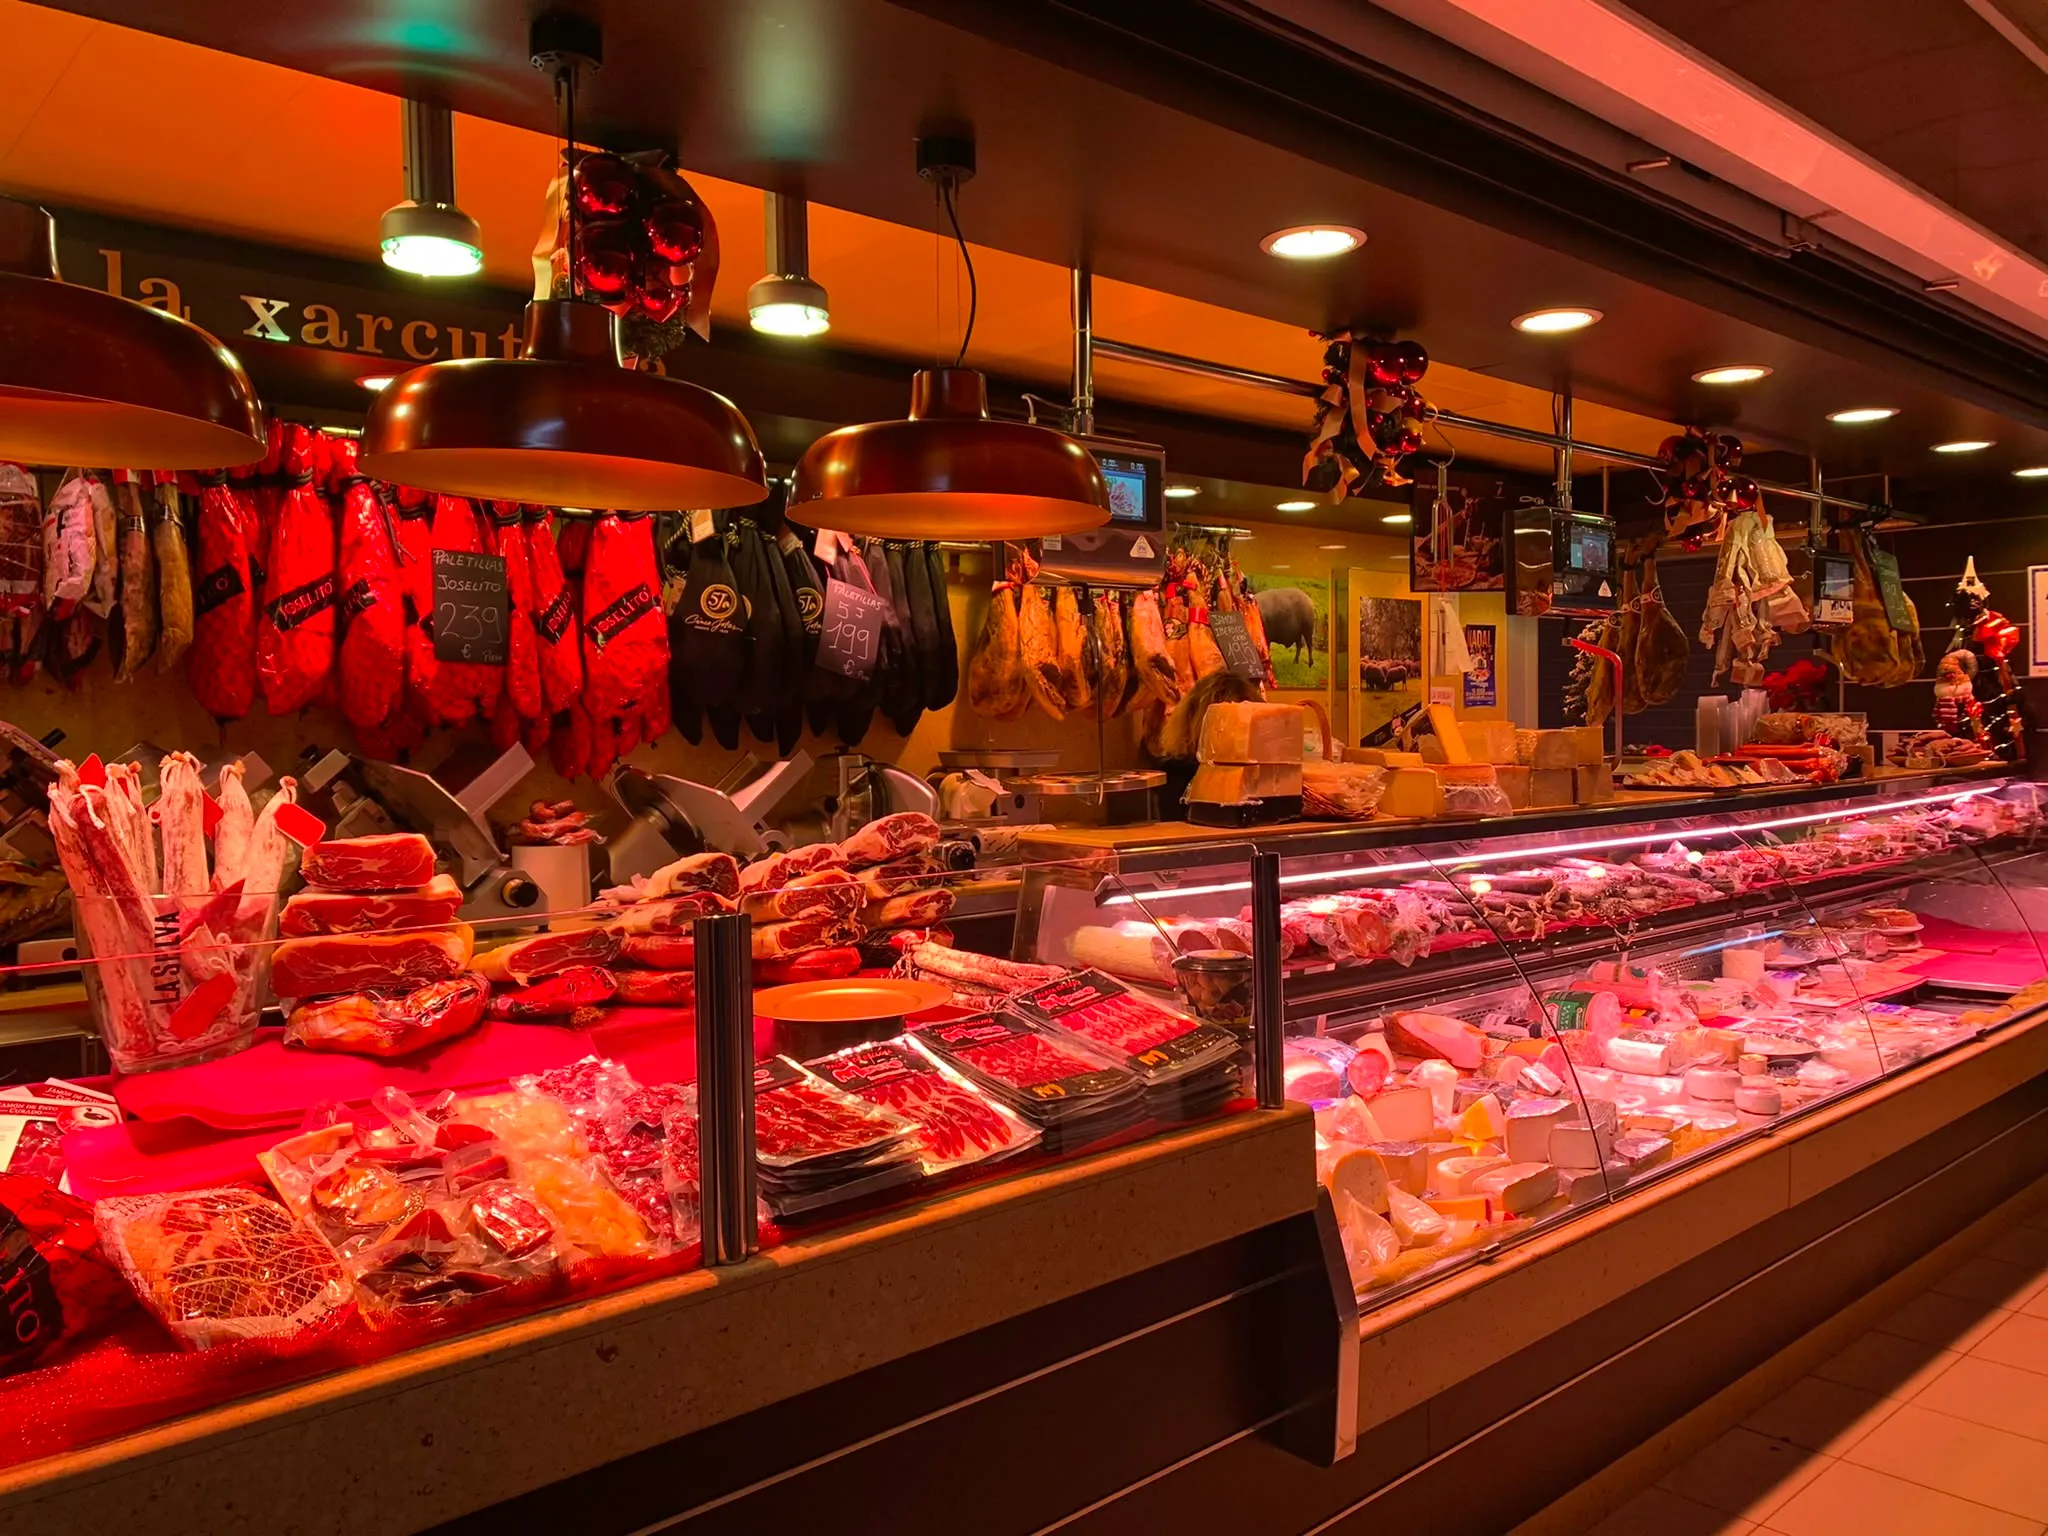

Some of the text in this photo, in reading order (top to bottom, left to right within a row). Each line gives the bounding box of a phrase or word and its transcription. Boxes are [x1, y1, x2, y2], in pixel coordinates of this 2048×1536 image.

[99, 250, 190, 322] la
[433, 549, 504, 572] PALETILLAS
[437, 574, 501, 592] JOSELITO
[708, 591, 728, 611] 5J
[440, 602, 502, 643] 239
[593, 590, 649, 634] JOSELITO
[826, 621, 869, 659] 199
